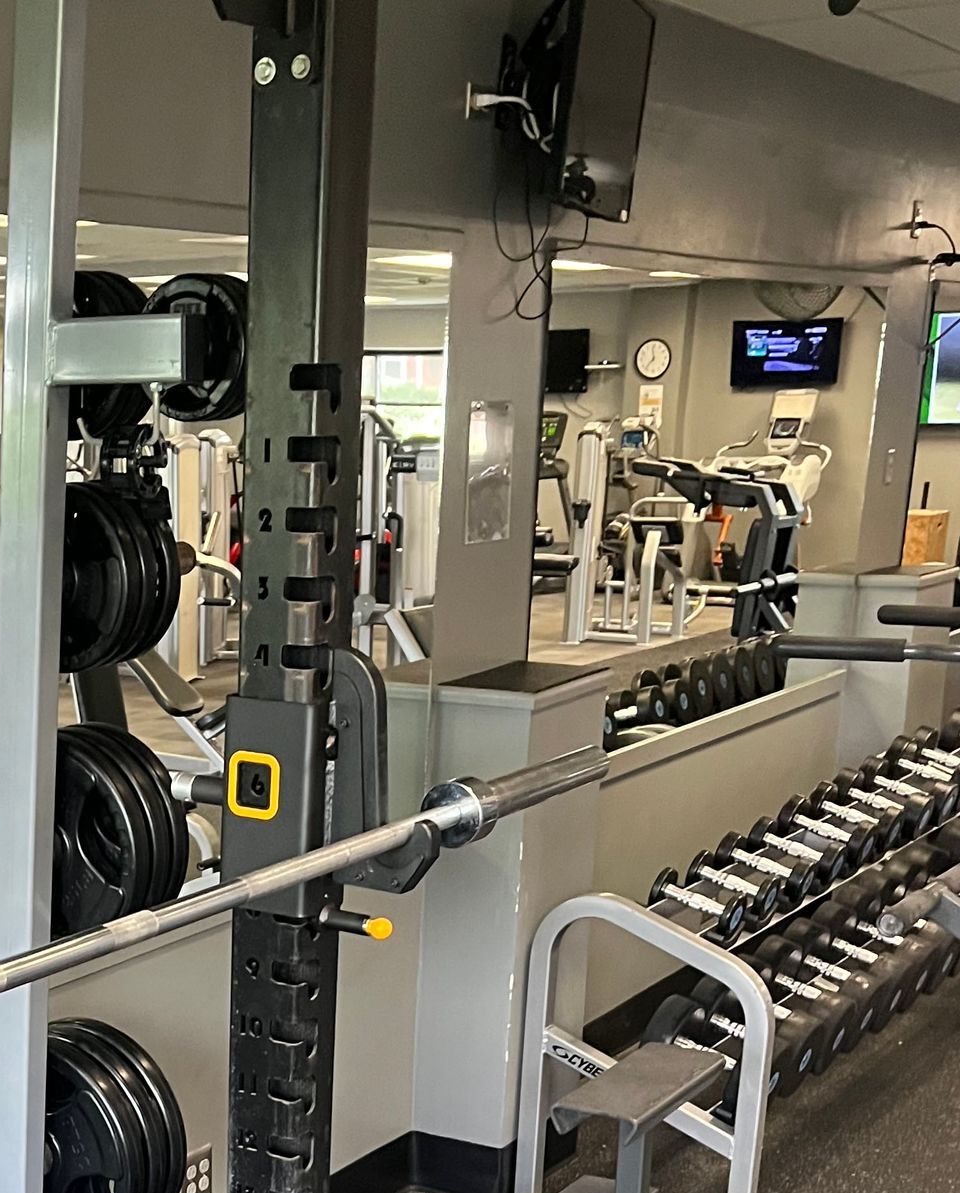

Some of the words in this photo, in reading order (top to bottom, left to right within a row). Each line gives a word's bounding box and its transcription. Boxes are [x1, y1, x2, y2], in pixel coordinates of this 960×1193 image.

[263, 438, 271, 463] 1
[258, 508, 273, 532] 2
[258, 576, 269, 600] 3
[254, 643, 269, 667] 4
[251, 773, 265, 796] 6
[245, 957, 259, 980] 9
[240, 1015, 262, 1038] 10
[568, 1054, 605, 1078] CYBE
[239, 1073, 256, 1096] 11
[238, 1128, 257, 1151] 12
